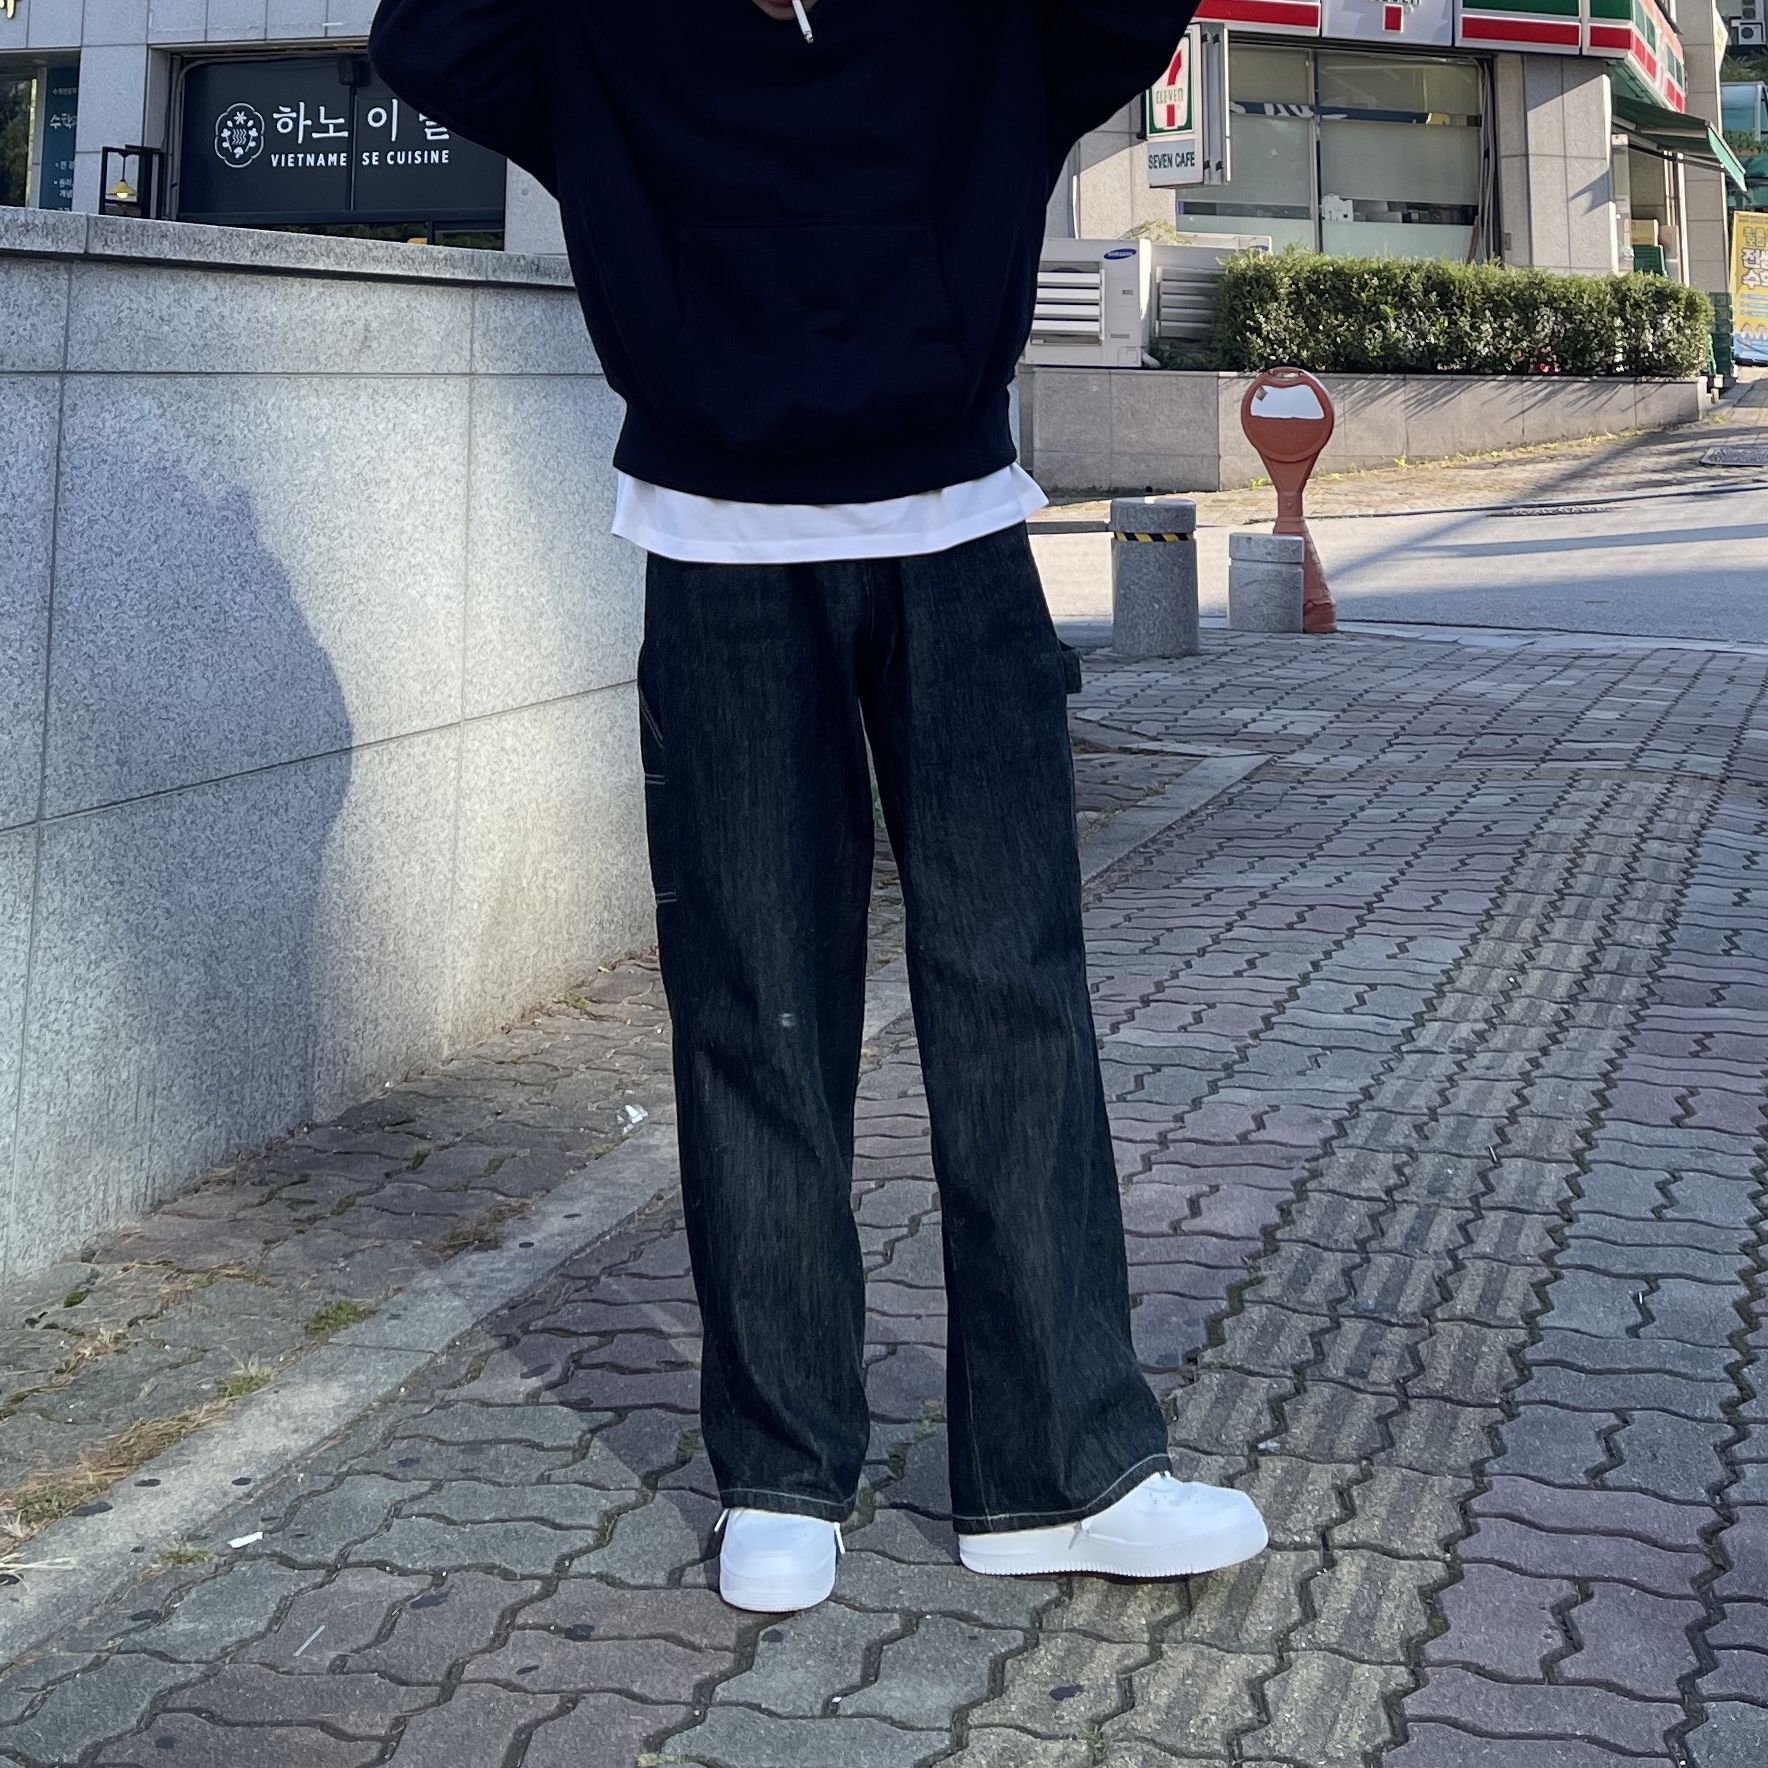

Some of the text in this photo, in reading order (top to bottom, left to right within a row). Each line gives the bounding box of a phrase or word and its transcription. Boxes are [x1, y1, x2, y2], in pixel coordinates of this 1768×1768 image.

[386, 150, 450, 165] CUISINE
[1148, 151, 1196, 170] SEVEN CAFE
